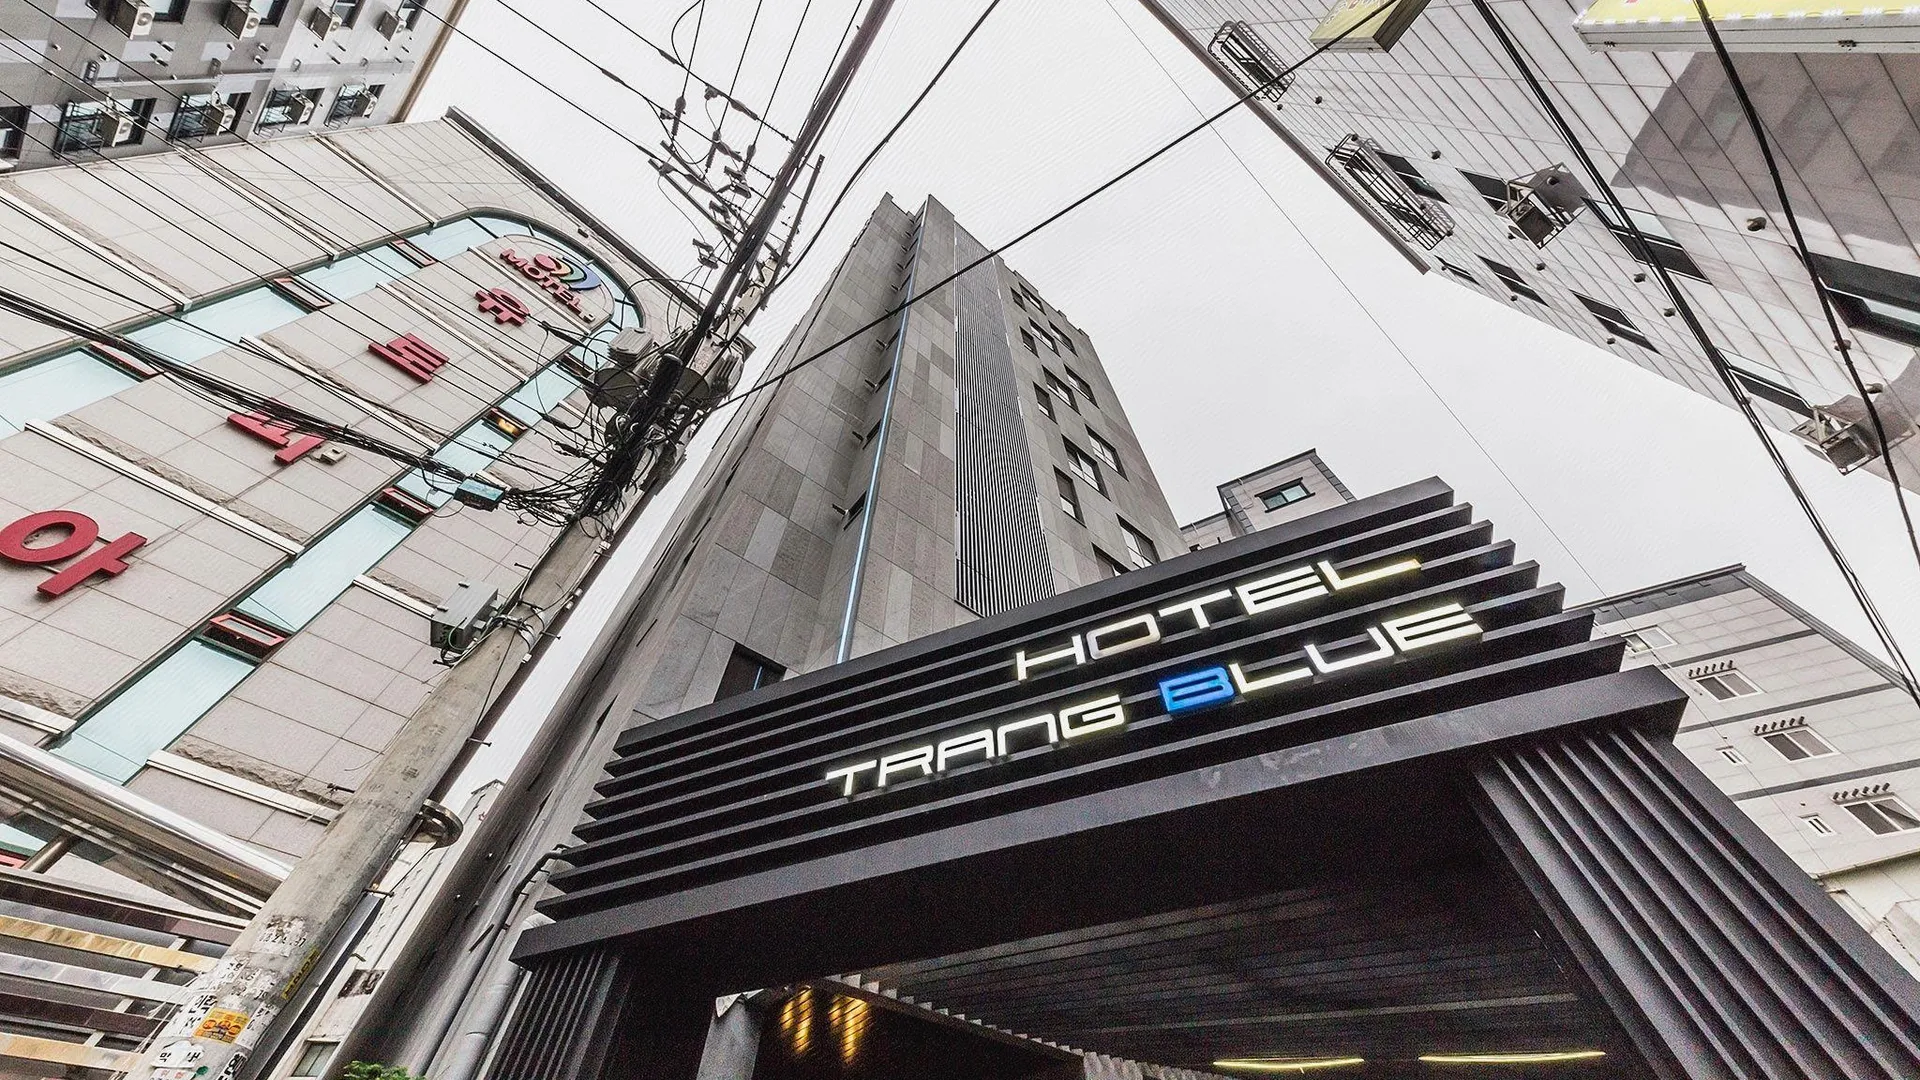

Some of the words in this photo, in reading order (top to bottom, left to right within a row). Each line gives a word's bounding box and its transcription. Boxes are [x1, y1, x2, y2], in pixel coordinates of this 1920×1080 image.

[500, 248, 580, 315] MOTEL
[1015, 559, 1422, 682] HOTEL
[826, 694, 1126, 797] TRANG
[1159, 602, 1483, 714] BLUE
